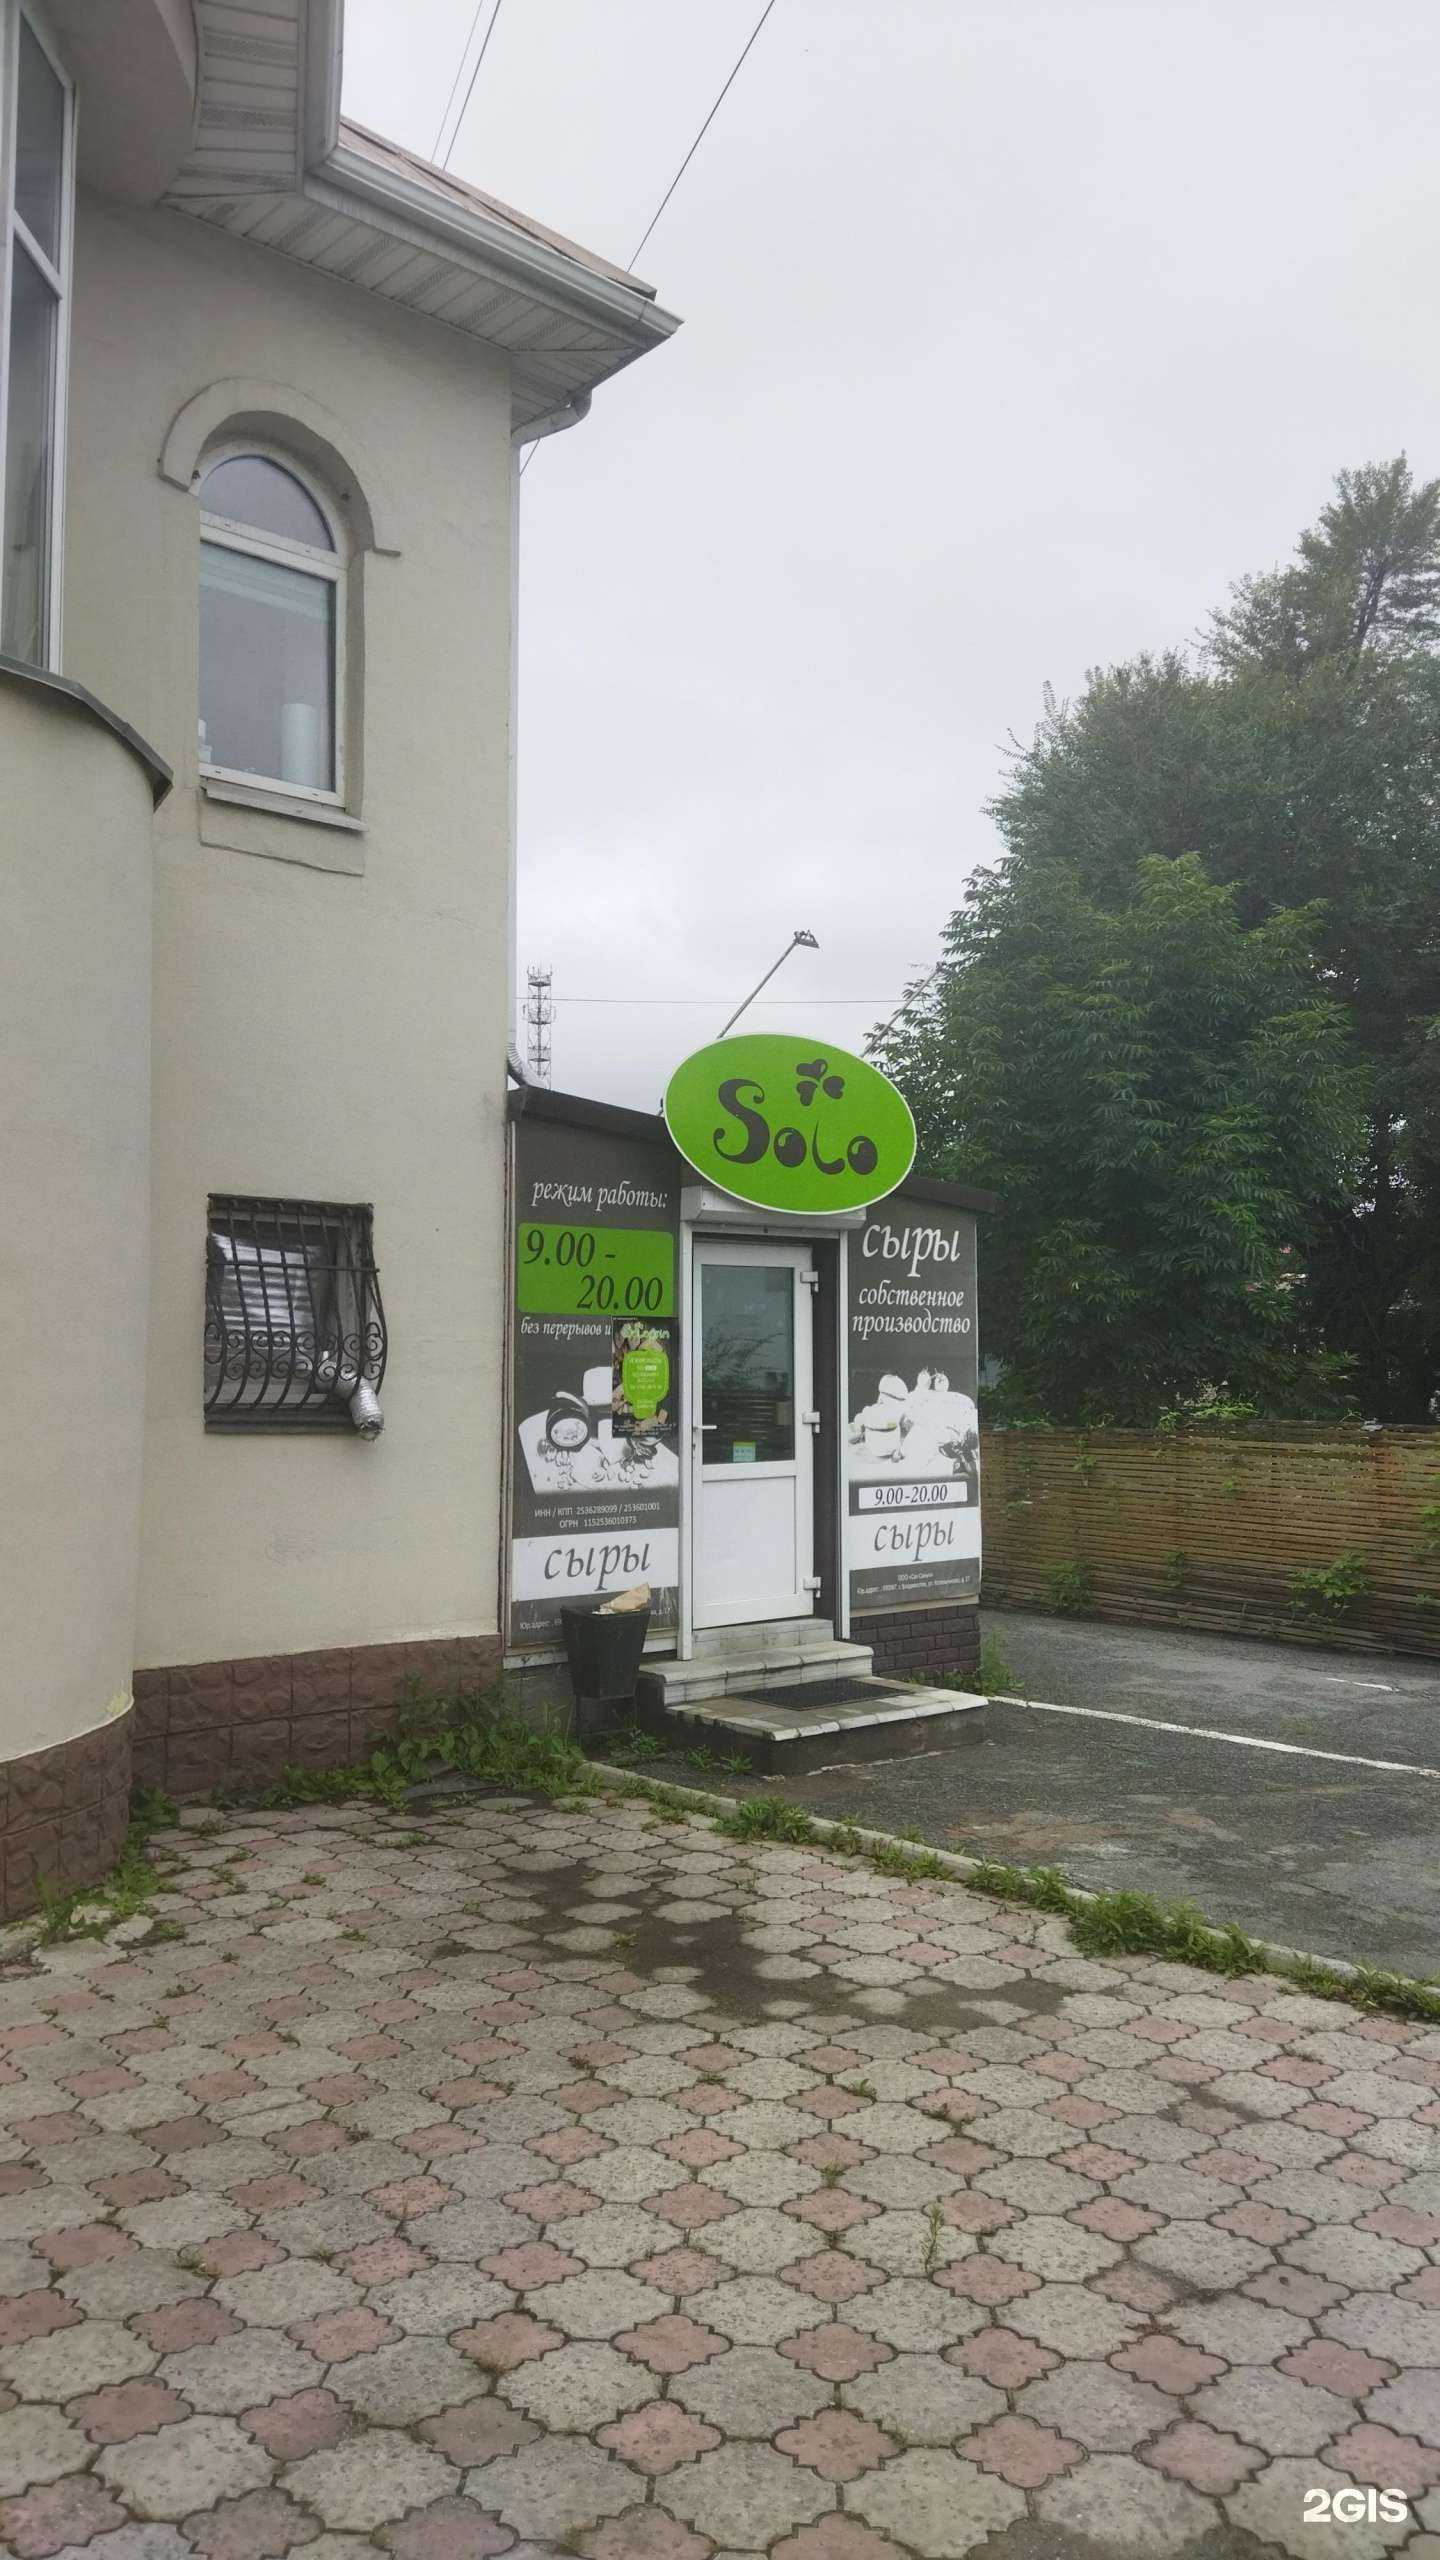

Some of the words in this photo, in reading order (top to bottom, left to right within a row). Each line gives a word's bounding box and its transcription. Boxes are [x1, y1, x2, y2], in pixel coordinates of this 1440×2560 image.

[531, 1182, 593, 1207] режим
[595, 1181, 668, 1211] работы:
[523, 1229, 596, 1268] 9.00
[576, 1274, 663, 1311] 20.00
[859, 1280, 964, 1307] собственное
[520, 1316, 540, 1335] без
[542, 1320, 602, 1340] перерывов
[852, 1307, 971, 1341] производство
[874, 1484, 948, 1506] 9.00-20.00
